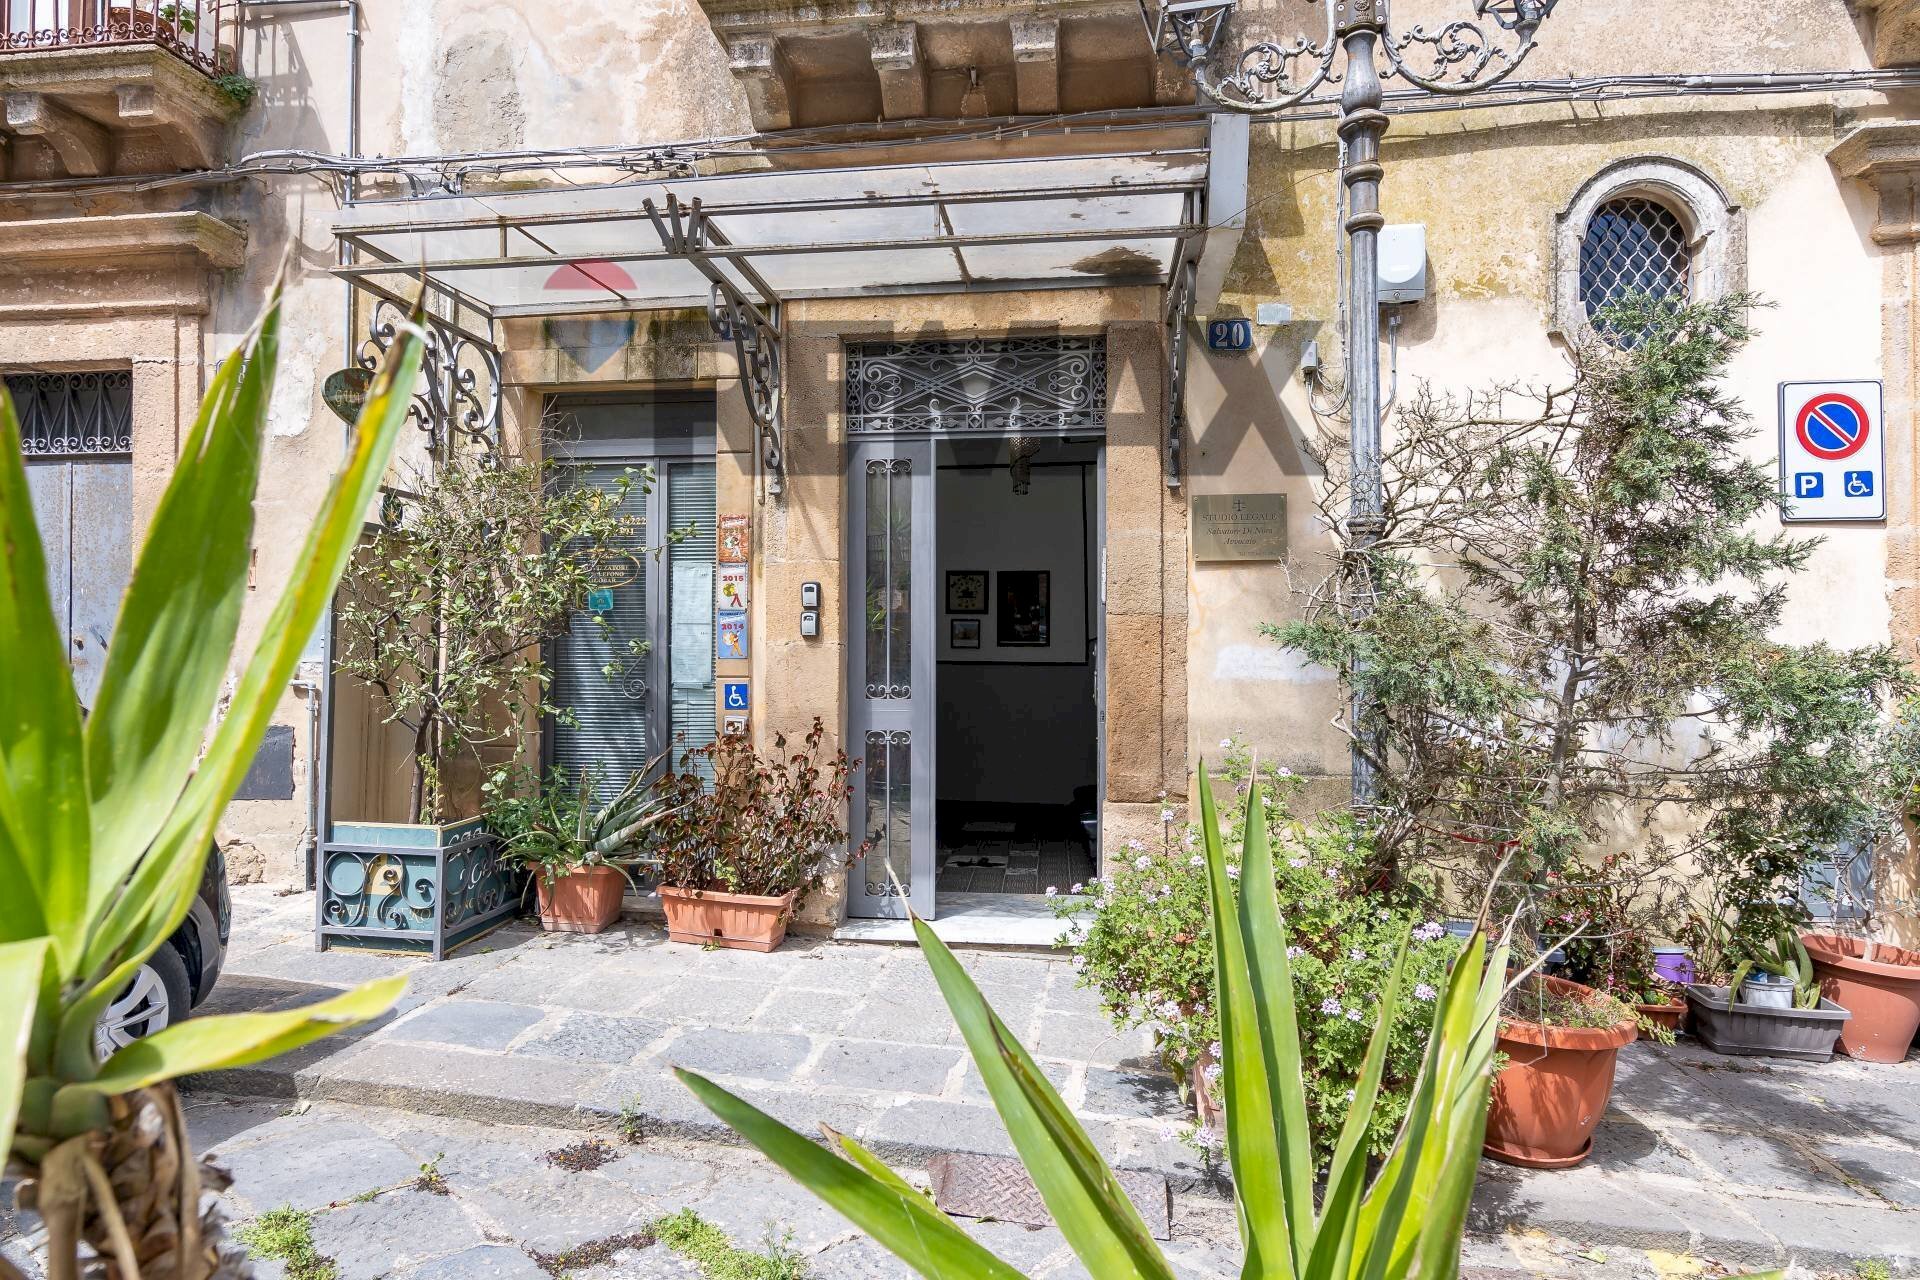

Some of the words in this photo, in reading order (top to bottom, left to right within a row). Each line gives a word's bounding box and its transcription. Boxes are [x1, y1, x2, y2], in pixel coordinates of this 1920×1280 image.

[1215, 323, 1245, 347] 20
[1800, 475, 1818, 496] P
[1202, 513, 1238, 521] STUDIO
[1240, 512, 1278, 521] LEGALE
